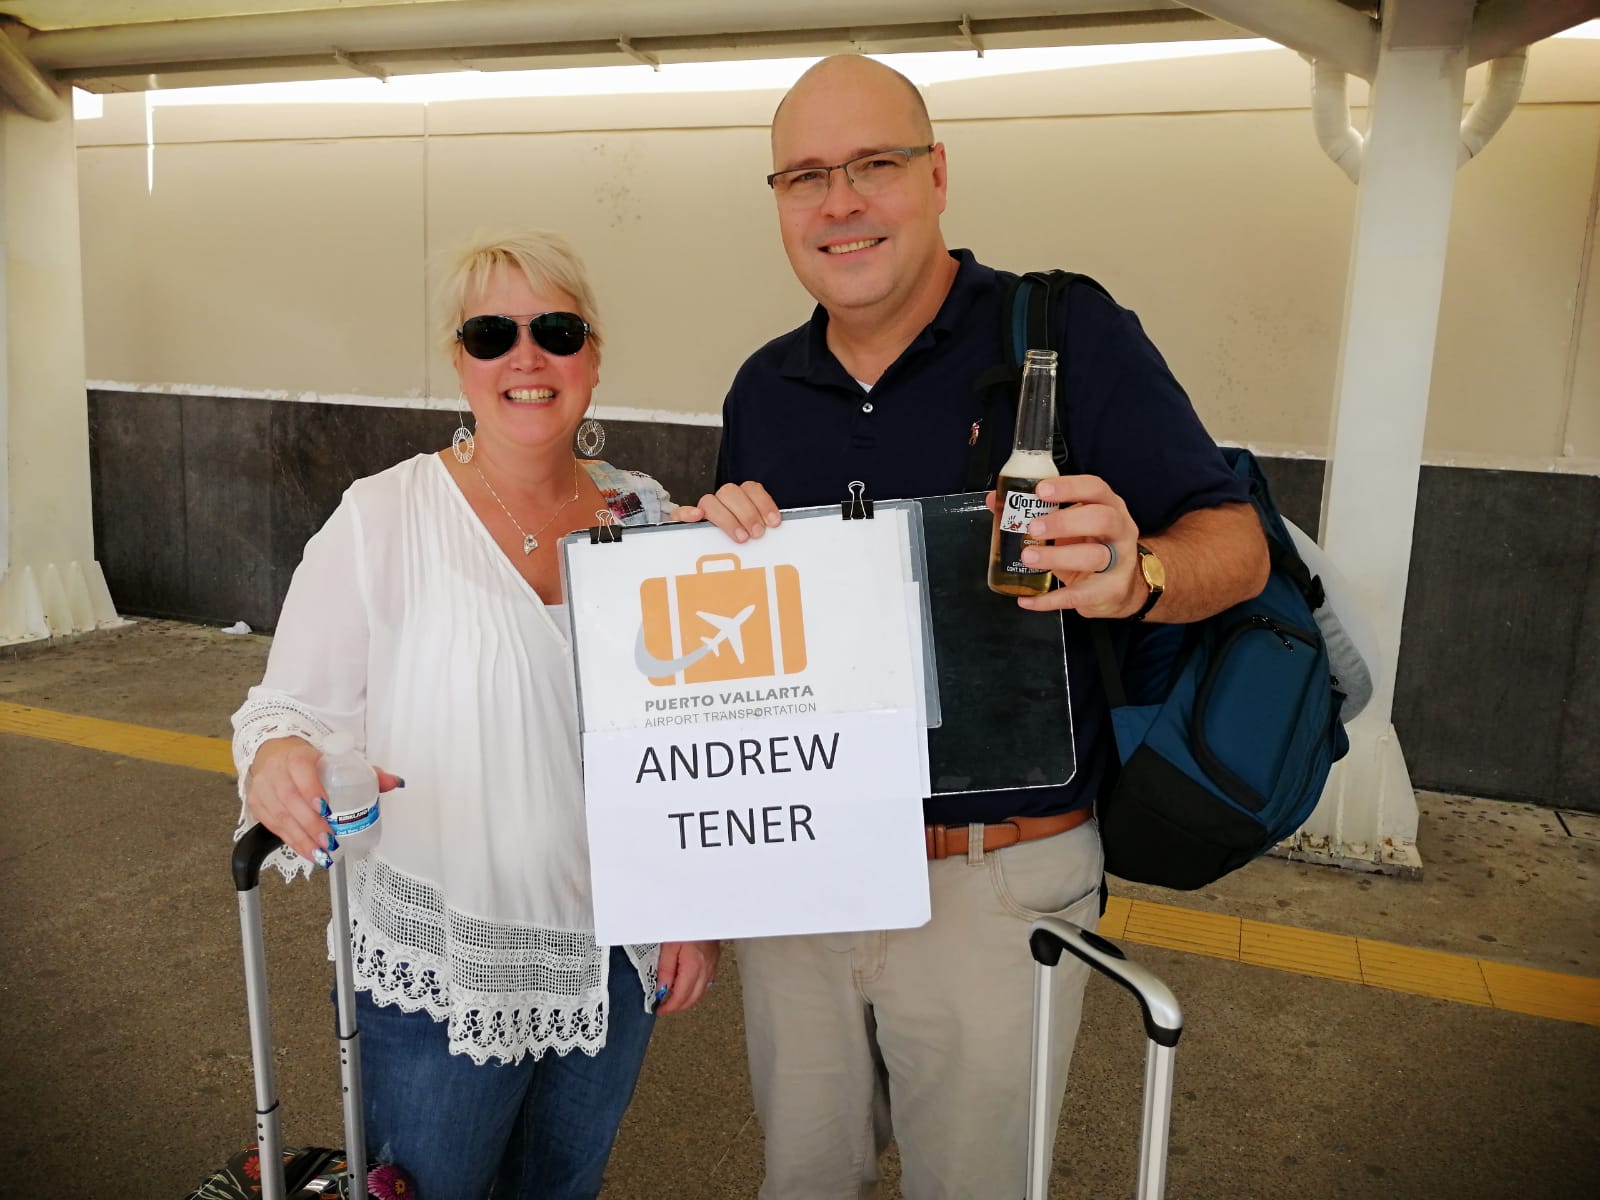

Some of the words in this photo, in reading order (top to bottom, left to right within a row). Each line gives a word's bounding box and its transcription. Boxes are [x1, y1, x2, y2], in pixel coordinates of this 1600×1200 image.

[645, 695, 714, 712] PUERTO
[720, 685, 814, 705] VALLARTA
[645, 713, 700, 728] AIRPORT
[704, 702, 816, 723] TRANSPORTATION
[636, 732, 839, 783] ANDREW
[668, 804, 816, 849] TENER
